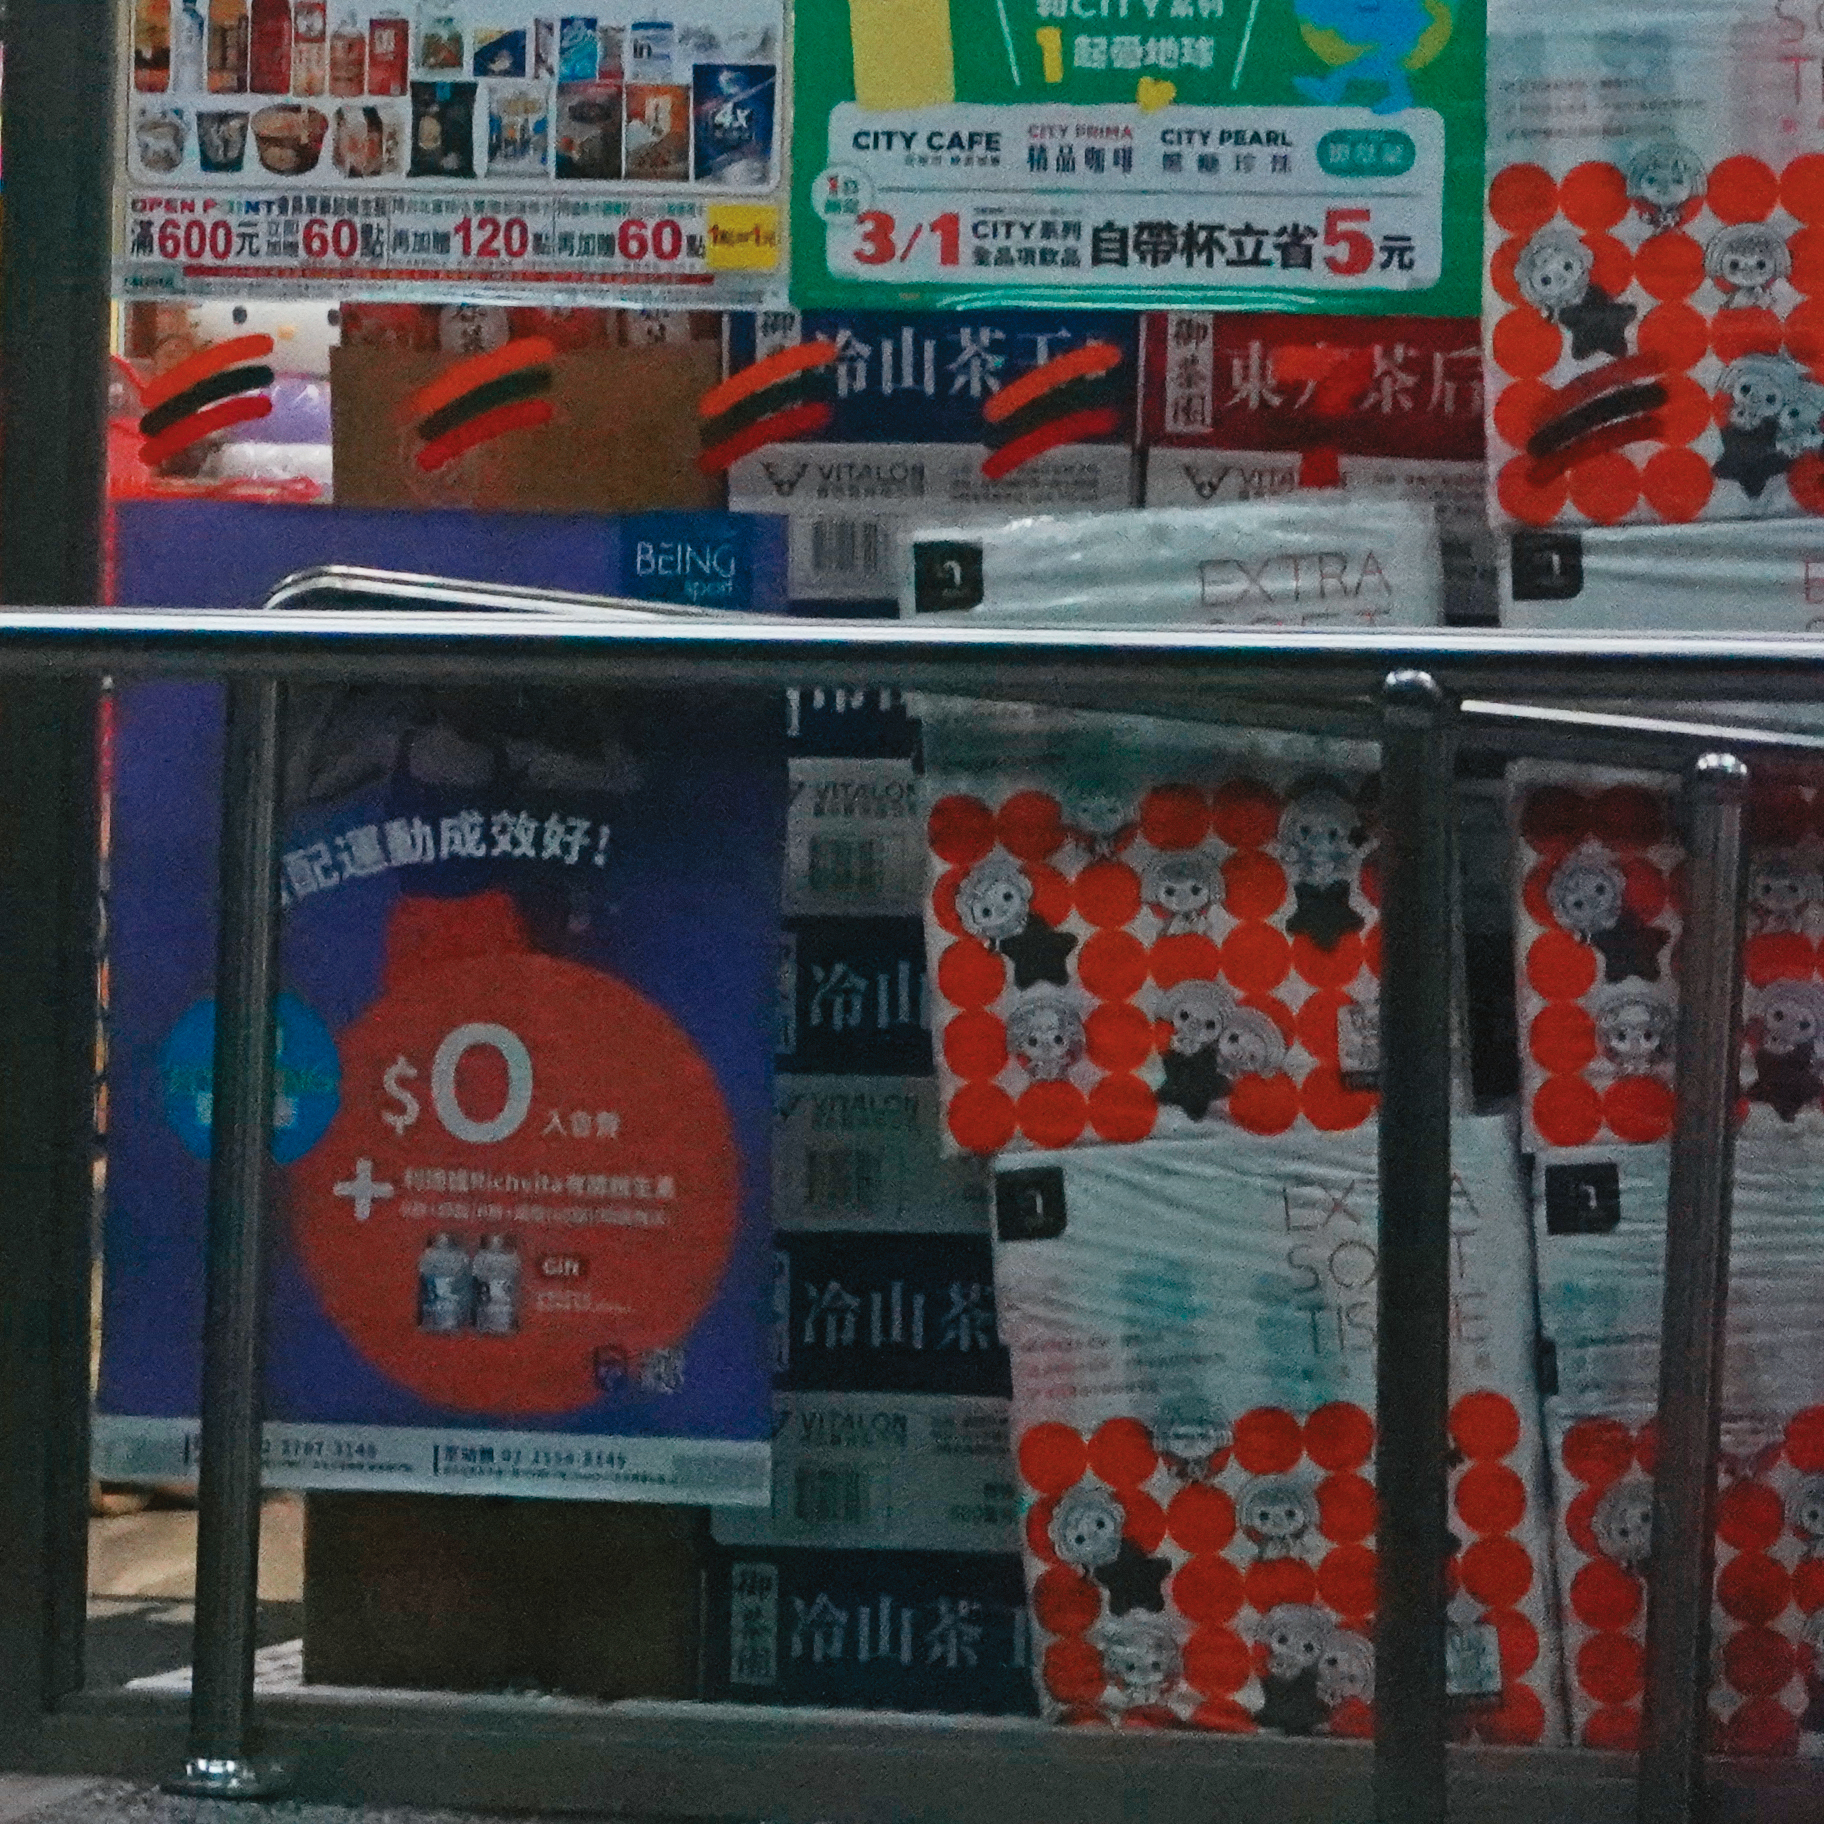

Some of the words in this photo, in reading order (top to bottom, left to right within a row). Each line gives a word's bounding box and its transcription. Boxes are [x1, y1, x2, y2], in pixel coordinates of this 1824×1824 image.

[851, 129, 919, 153] CITY
[926, 129, 1002, 153] CAFE
[1159, 128, 1212, 147] CITY
[1218, 128, 1294, 148] PEARL
[853, 209, 961, 266] 3/1
